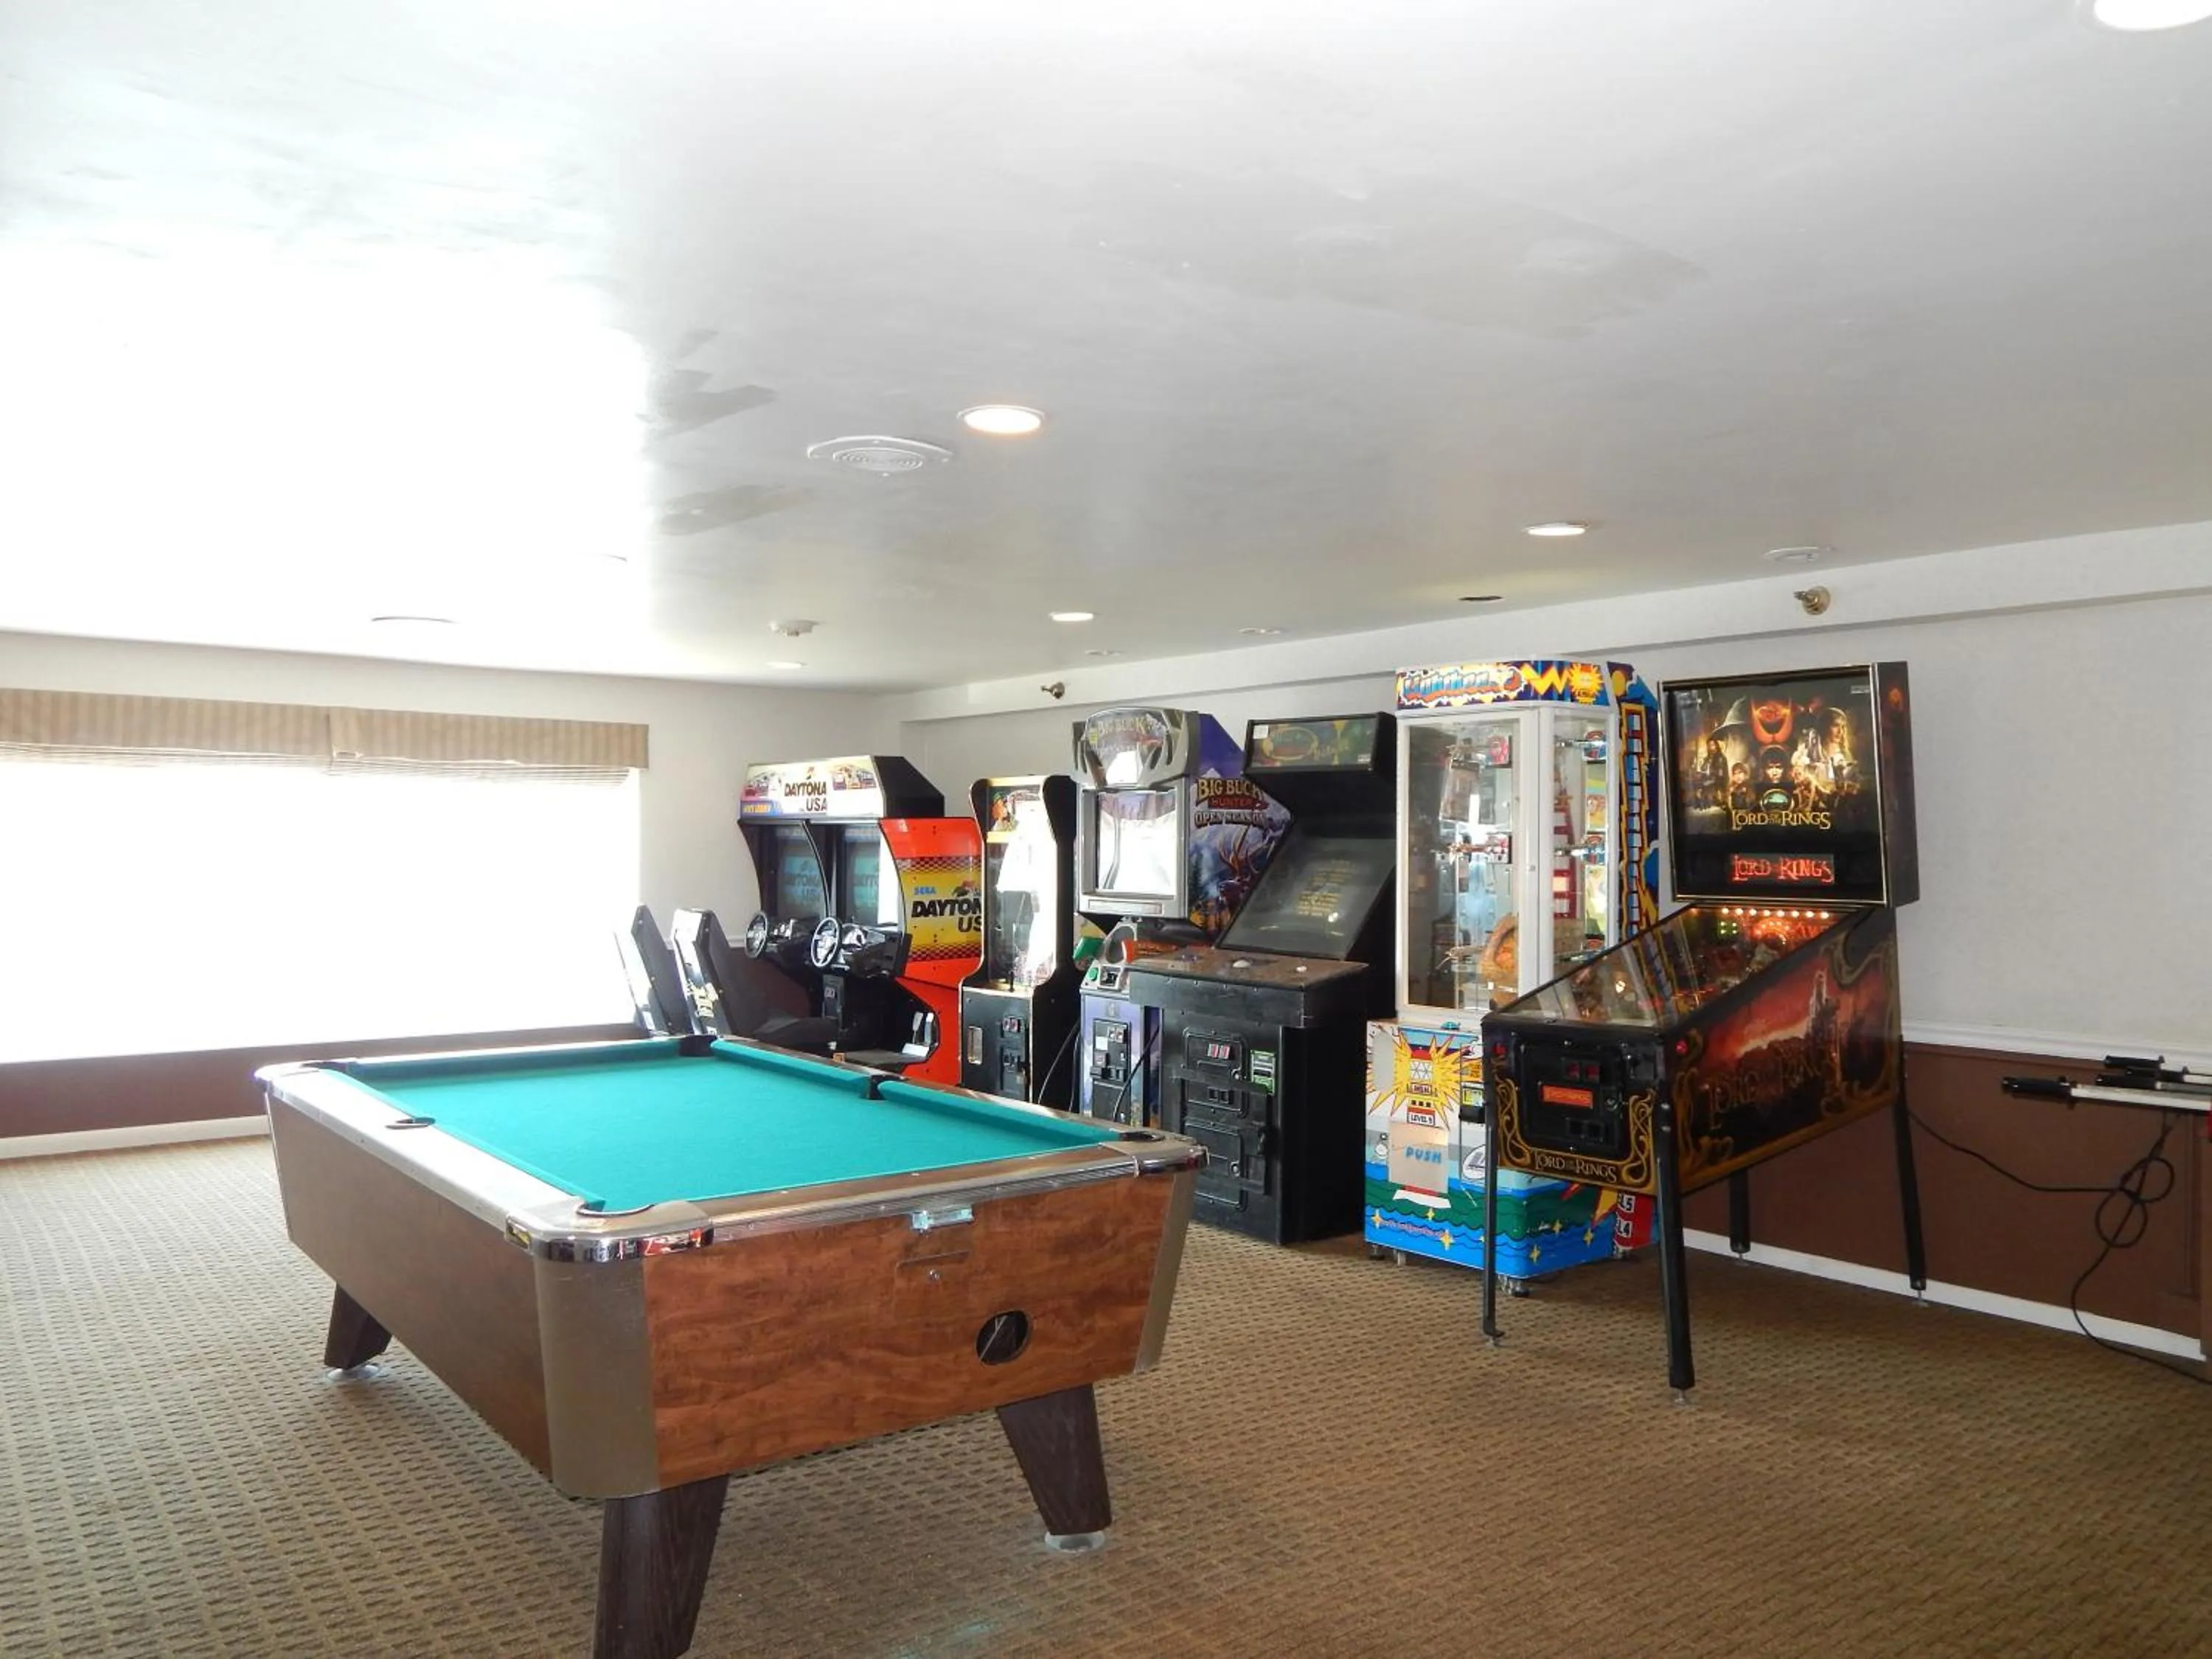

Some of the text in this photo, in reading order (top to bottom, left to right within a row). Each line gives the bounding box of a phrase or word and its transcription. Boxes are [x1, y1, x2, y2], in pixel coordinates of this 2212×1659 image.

[784, 781, 827, 797] DAYTONA
[1197, 778, 1263, 800] BIG BUCK
[806, 798, 827, 812] USA
[1194, 812, 1223, 826] OPEN
[1732, 810, 1769, 830] LORD
[1781, 811, 1831, 830] RINGS
[911, 897, 981, 918] DAYTON
[958, 915, 981, 933] US
[1411, 1114, 1427, 1123] LEVEL
[1405, 1146, 1442, 1165] PUSH
[1535, 1151, 1565, 1169] LORD
[1576, 1158, 1617, 1183] RINGS
